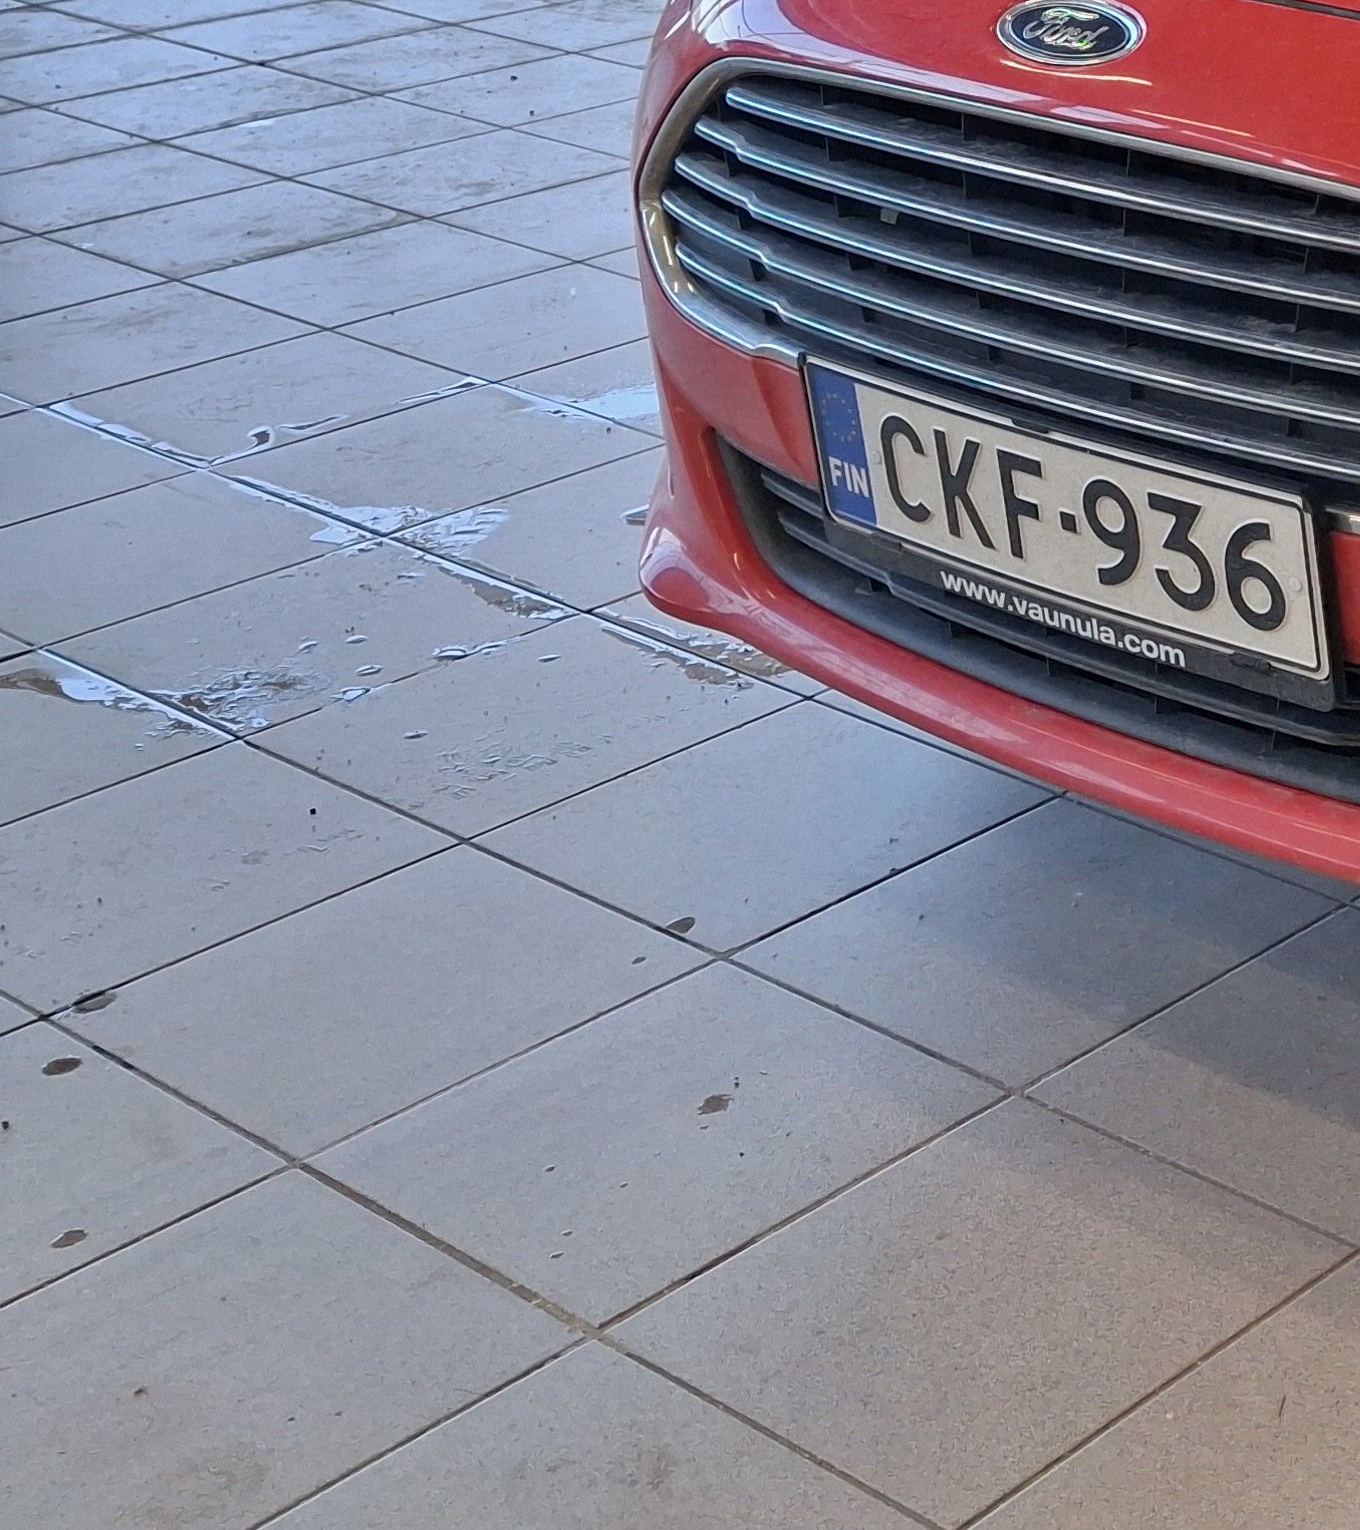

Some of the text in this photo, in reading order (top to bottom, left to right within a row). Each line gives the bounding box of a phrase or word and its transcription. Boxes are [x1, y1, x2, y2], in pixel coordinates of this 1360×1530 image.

[1022, 7, 1110, 51] Ford
[830, 461, 870, 499] FIN
[880, 414, 1287, 632] CKF-936
[942, 570, 1187, 668] www.vaunula.com
